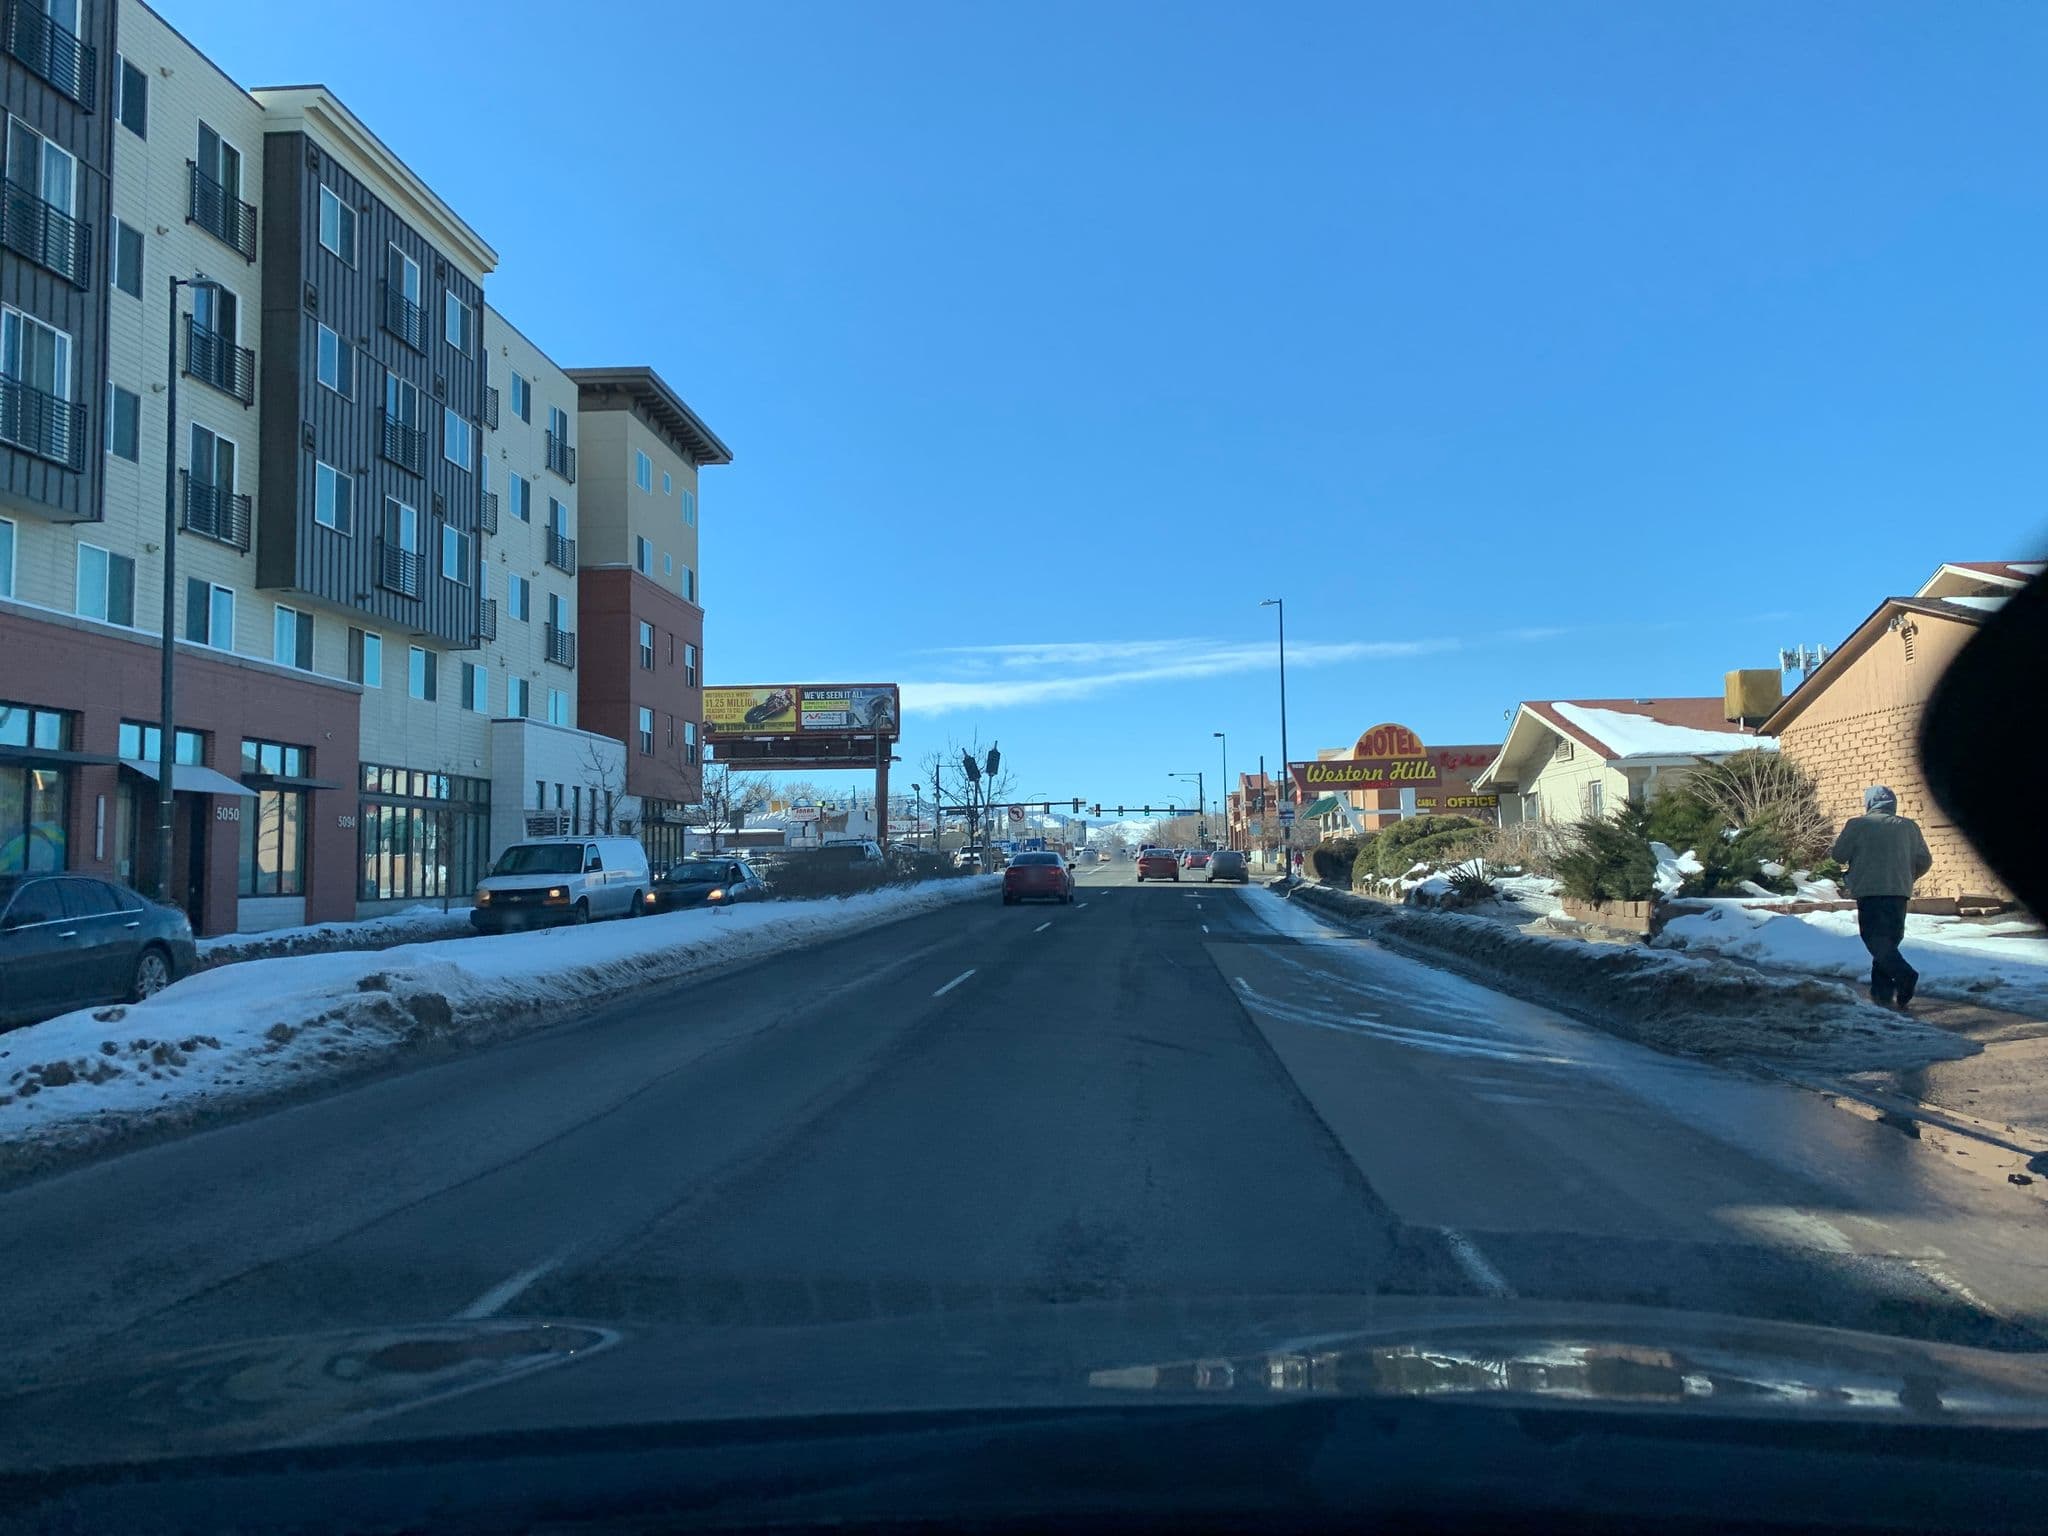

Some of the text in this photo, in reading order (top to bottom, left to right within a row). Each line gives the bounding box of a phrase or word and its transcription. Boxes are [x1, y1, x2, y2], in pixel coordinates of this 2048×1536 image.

[804, 690, 863, 699] WE'VE SEEN IT ALL
[727, 698, 758, 708] MILLION
[1357, 726, 1422, 756] MOTEL
[1306, 764, 1384, 783] Western
[1389, 761, 1437, 781] Hills
[1446, 796, 1497, 808] OFFICE
[216, 806, 240, 822] 5050
[337, 815, 356, 828] 5094
